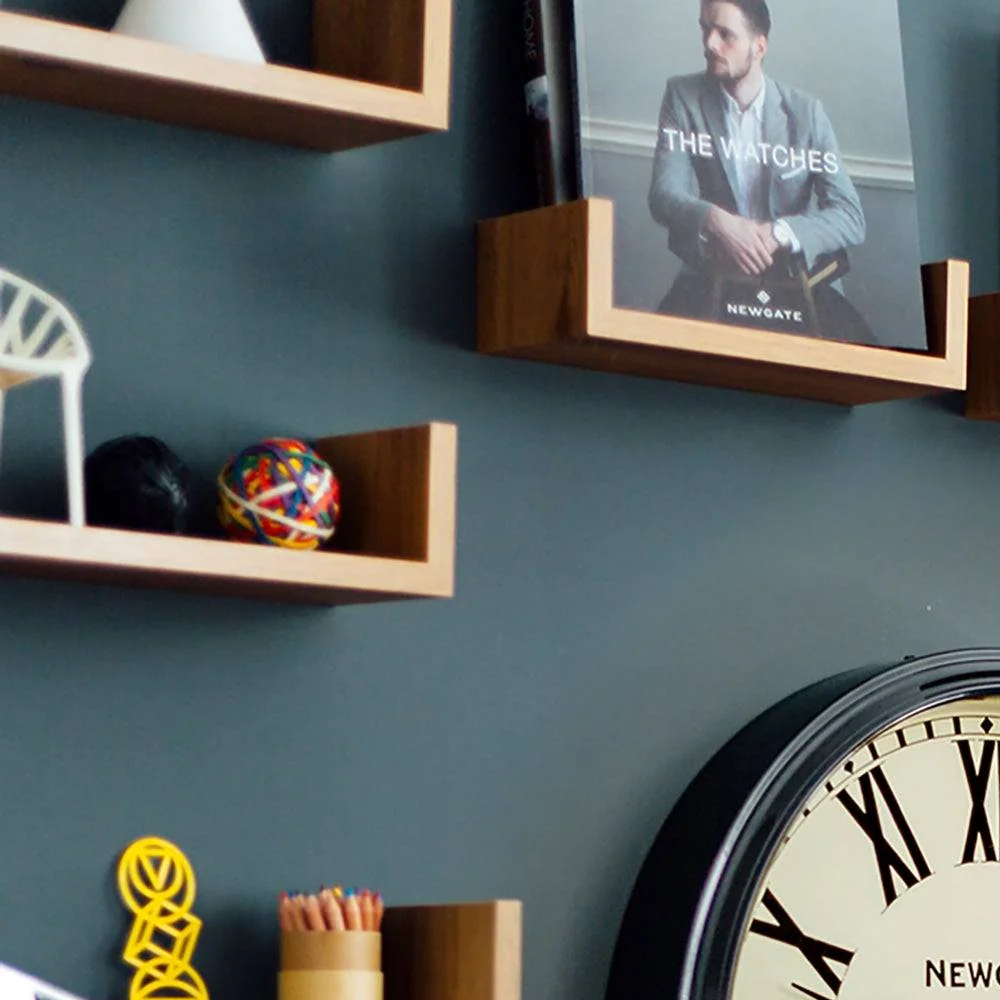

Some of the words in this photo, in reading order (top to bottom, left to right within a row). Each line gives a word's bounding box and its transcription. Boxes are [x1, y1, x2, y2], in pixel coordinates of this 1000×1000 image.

[663, 128, 713, 158] THE
[719, 136, 839, 174] WATCHES
[727, 303, 803, 323] NEWGATE
